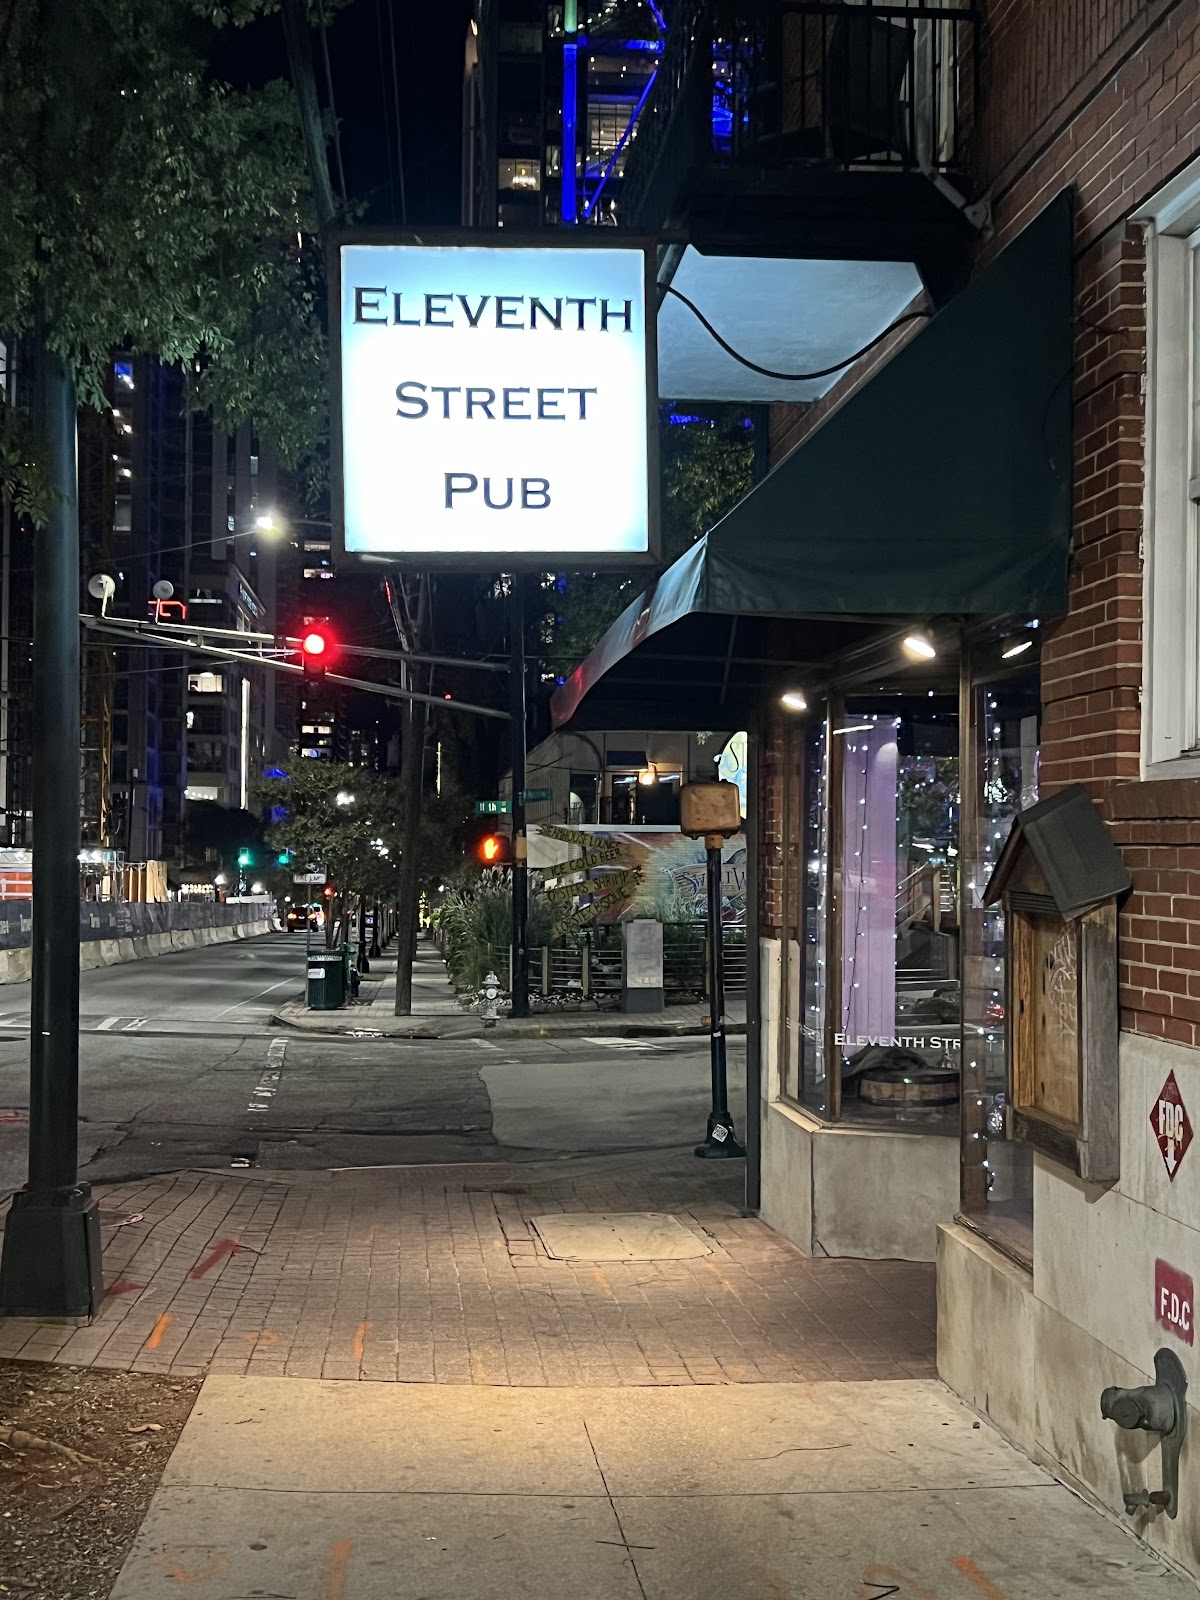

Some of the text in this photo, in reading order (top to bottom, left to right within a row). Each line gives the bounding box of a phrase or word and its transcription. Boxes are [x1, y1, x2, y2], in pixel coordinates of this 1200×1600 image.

[352, 285, 633, 333] ELEVENTH
[395, 381, 598, 421] STREET
[444, 472, 552, 510] PUB
[541, 823, 588, 846] STEAMHOUSE
[550, 847, 622, 878] ICE COLD BEER
[547, 871, 629, 902] OYSTERS SHRIMP
[554, 886, 630, 935] LOBSTER BISQUE
[834, 1033, 925, 1048] ELEVENTH
[1158, 1099, 1184, 1142] FDC
[1161, 1286, 1190, 1331] F.D.C
